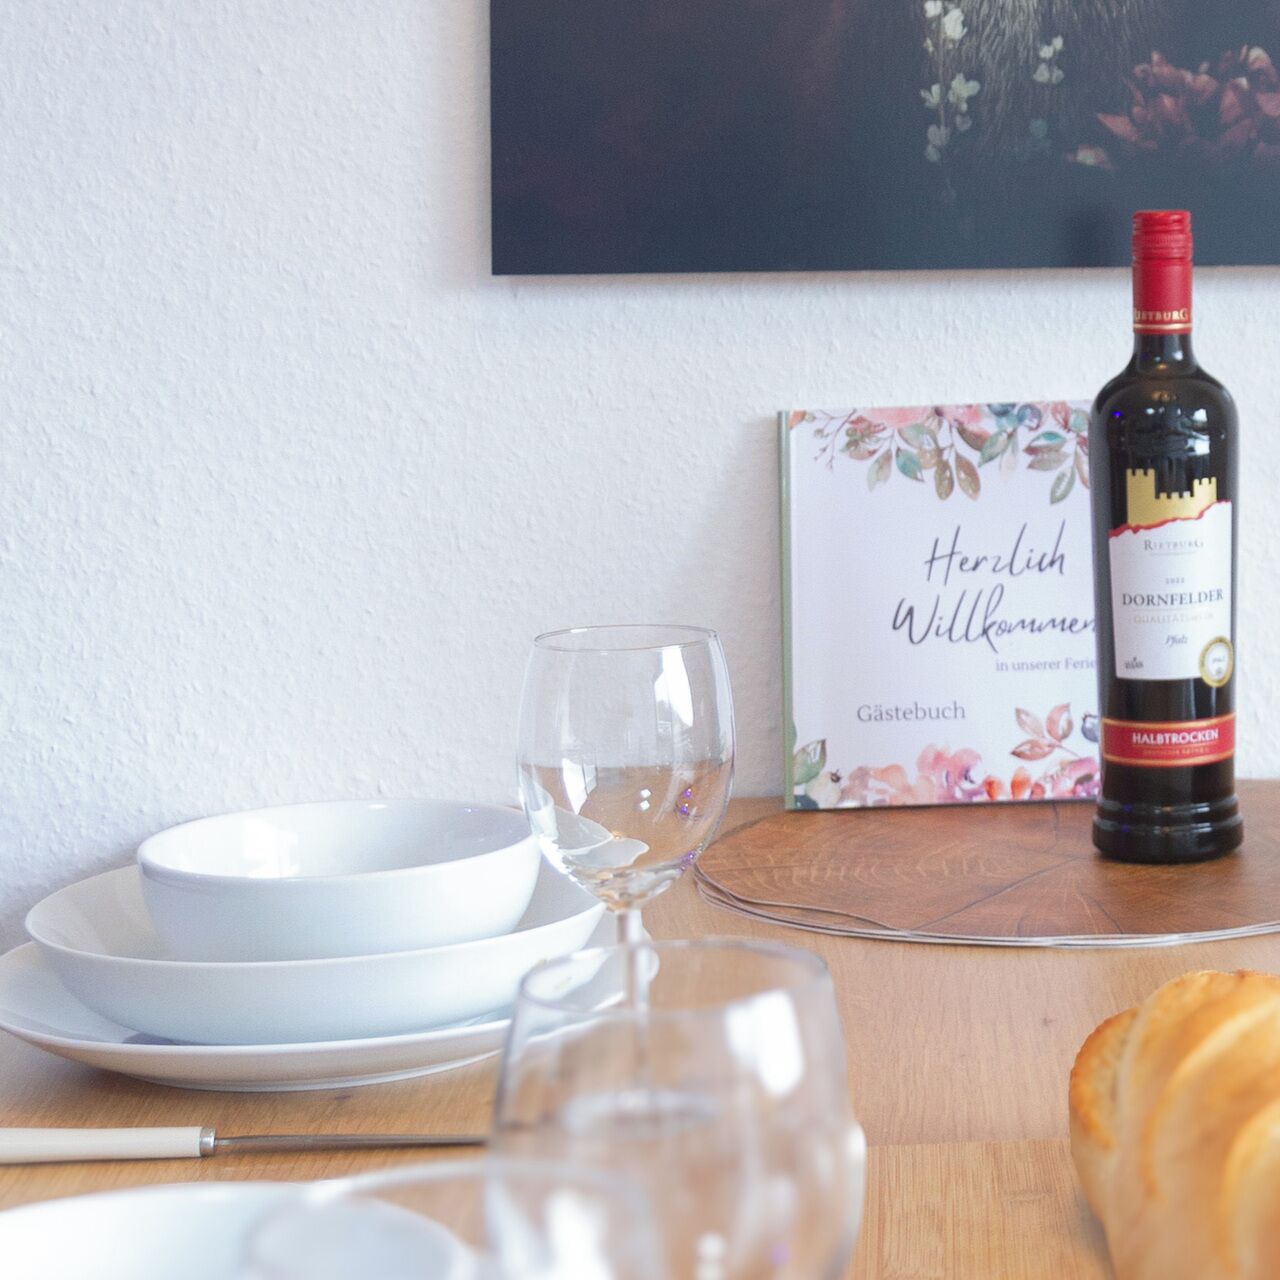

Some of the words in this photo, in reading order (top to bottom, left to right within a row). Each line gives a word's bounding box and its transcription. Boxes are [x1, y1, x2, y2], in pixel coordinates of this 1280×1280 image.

[924, 519, 1066, 586] Herzlich
[1122, 588, 1224, 607] DORNFELDER
[892, 583, 1096, 654] Willkommen
[995, 658, 1009, 671] in
[1011, 660, 1062, 671] unserer
[856, 700, 967, 723] Gästebuch
[1132, 728, 1219, 745] HALBTROCKEN
